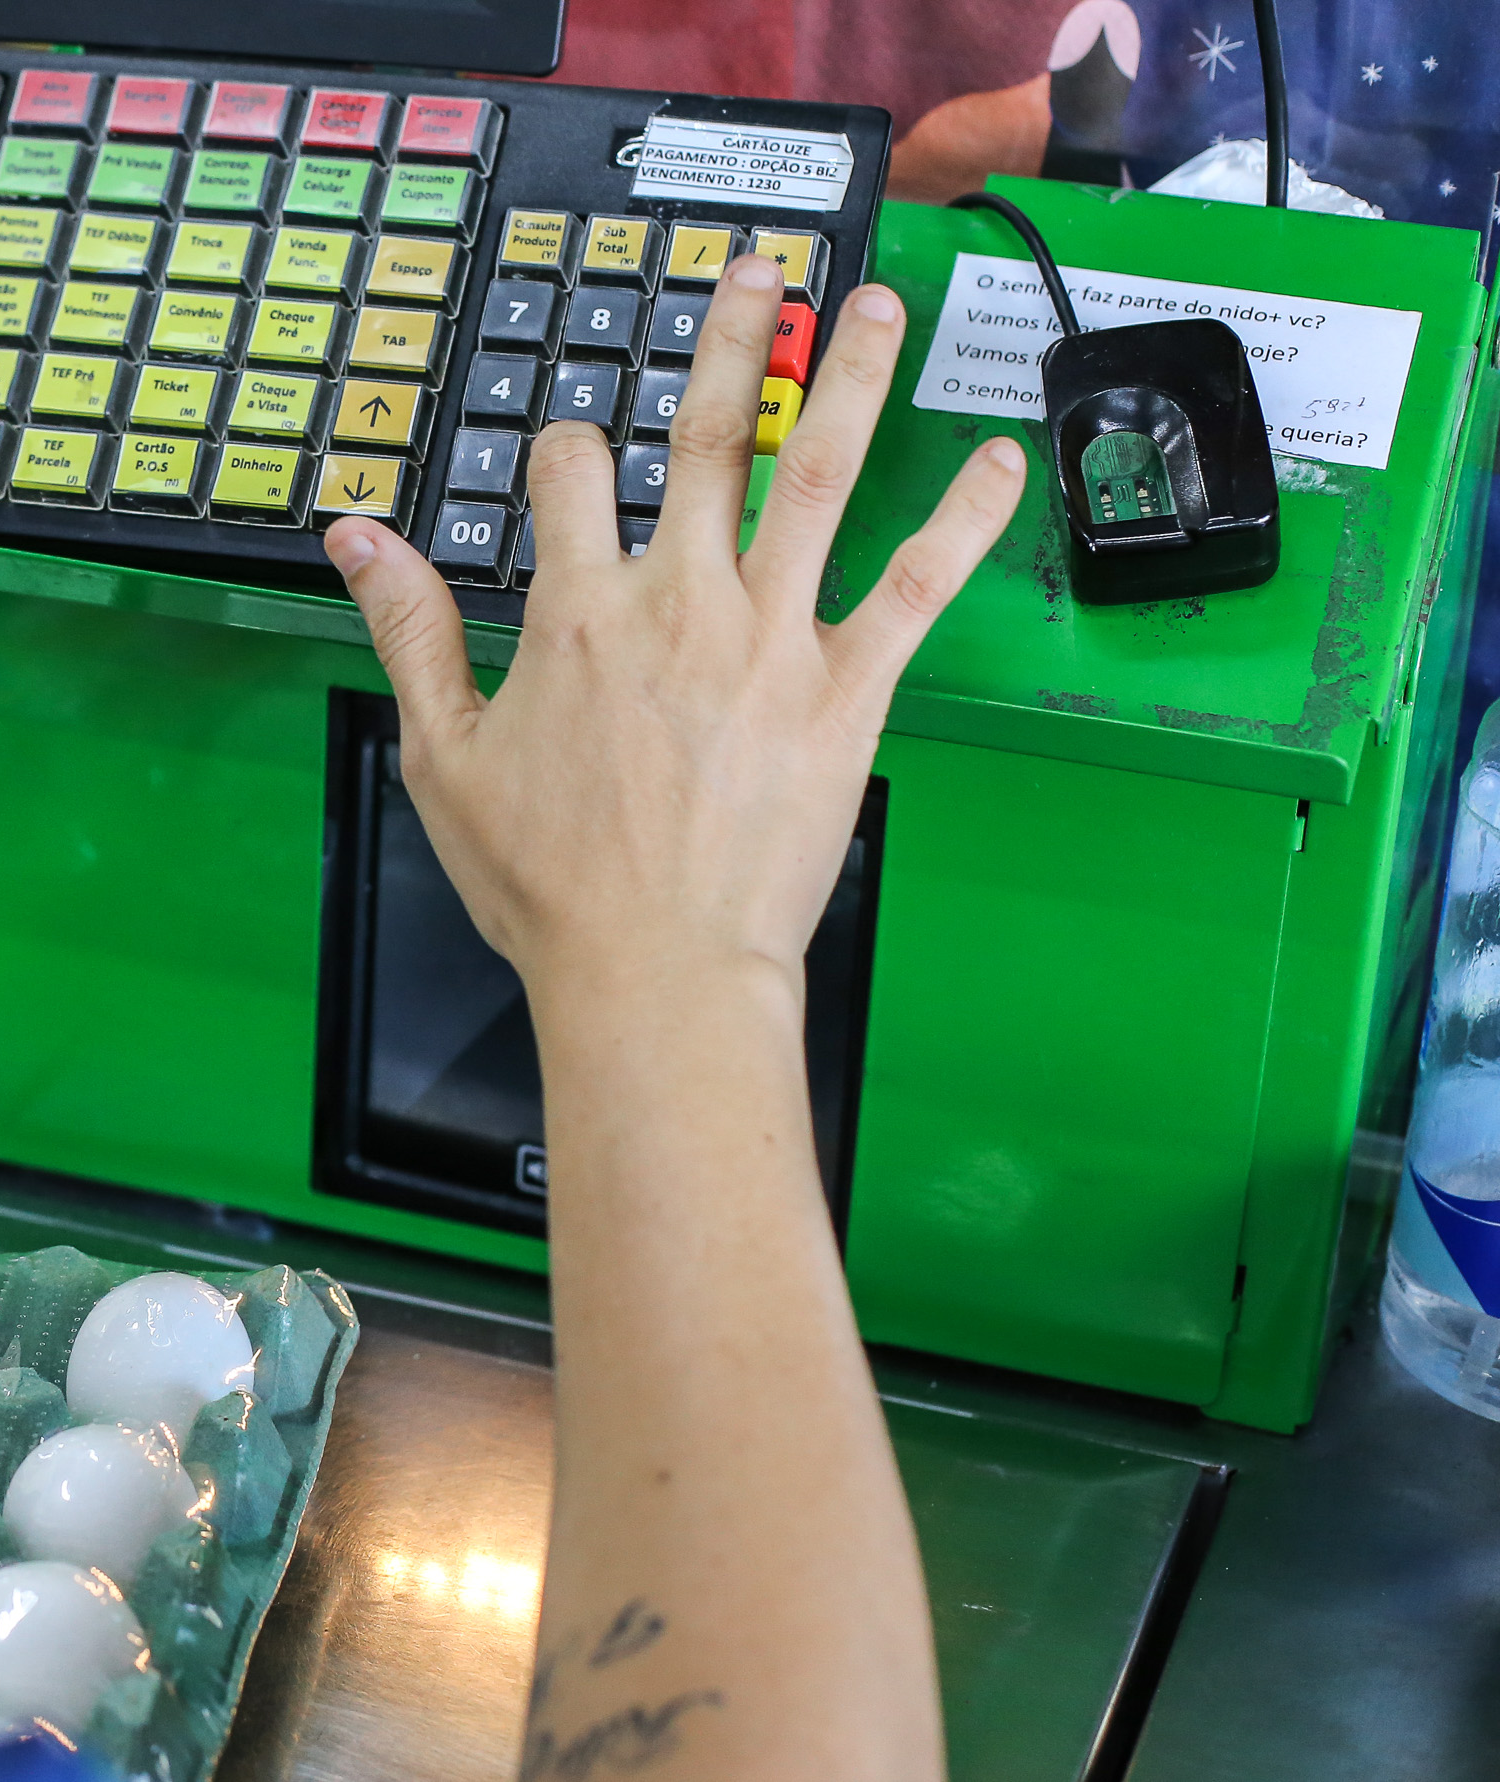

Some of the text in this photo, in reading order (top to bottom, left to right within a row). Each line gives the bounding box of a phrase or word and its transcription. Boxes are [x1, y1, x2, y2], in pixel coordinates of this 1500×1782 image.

[320, 100, 367, 113] Cancela
[417, 106, 463, 119] Cancela
[722, 137, 812, 157] CARTÃO UZE
[126, 158, 163, 170] Venda
[645, 148, 737, 169] PAGAMENTO
[750, 157, 800, 175] OPÇÃO
[803, 165, 812, 176] 5
[304, 162, 352, 179] Recarga
[398, 171, 456, 185] Desconto
[640, 166, 735, 187] VENCIMENTO
[747, 178, 782, 191] 1230
[303, 180, 345, 194] Celular
[401, 188, 443, 202] Cupom
[0, 215, 39, 229] Pontos
[515, 218, 562, 232] Consulta
[85, 226, 148, 245] TEF Débito
[604, 225, 627, 239] Sub
[191, 235, 223, 249] Troca
[290, 237, 327, 252] Venda
[513, 234, 557, 248] Produto
[596, 241, 628, 255] Total
[288, 255, 319, 269] Func.
[541, 250, 556, 261] (Y)
[390, 261, 433, 278] Espaço
[91, 290, 111, 304] TEF
[976, 274, 1326, 331] O senhr faz parte do nido+ vc?
[64, 304, 127, 322] Vencimento
[168, 304, 225, 321] Convênio
[269, 309, 316, 326] Cheque
[509, 301, 529, 323] 7
[590, 308, 611, 330] 8
[967, 307, 1039, 331] Vamos
[277, 326, 299, 339] Pré
[673, 314, 694, 336] 9
[382, 332, 407, 348] TAB
[301, 344, 316, 356] (P)
[955, 341, 1028, 365] Vamos
[52, 366, 96, 382] TEF Pré
[153, 379, 190, 394] Ticket
[251, 381, 298, 399] Cheque
[490, 377, 510, 399] 4
[572, 385, 593, 408] 5
[179, 407, 197, 418] (M)
[246, 399, 289, 414] a Vista
[657, 394, 677, 417] 6
[943, 378, 960, 393] O
[966, 384, 1042, 405] senhor
[1280, 423, 1369, 450] queria?
[281, 420, 297, 430] (Q)
[43, 439, 65, 452] TEF
[134, 440, 176, 456] Cartão
[27, 453, 72, 469] Parcela
[135, 459, 169, 473] P.O.S
[231, 456, 284, 474] Dinheiro
[477, 448, 493, 471] 1
[66, 474, 79, 486] (J)
[645, 463, 665, 486] 3
[164, 477, 180, 489] (N)
[266, 486, 282, 498] (R)
[450, 521, 492, 545] 00
